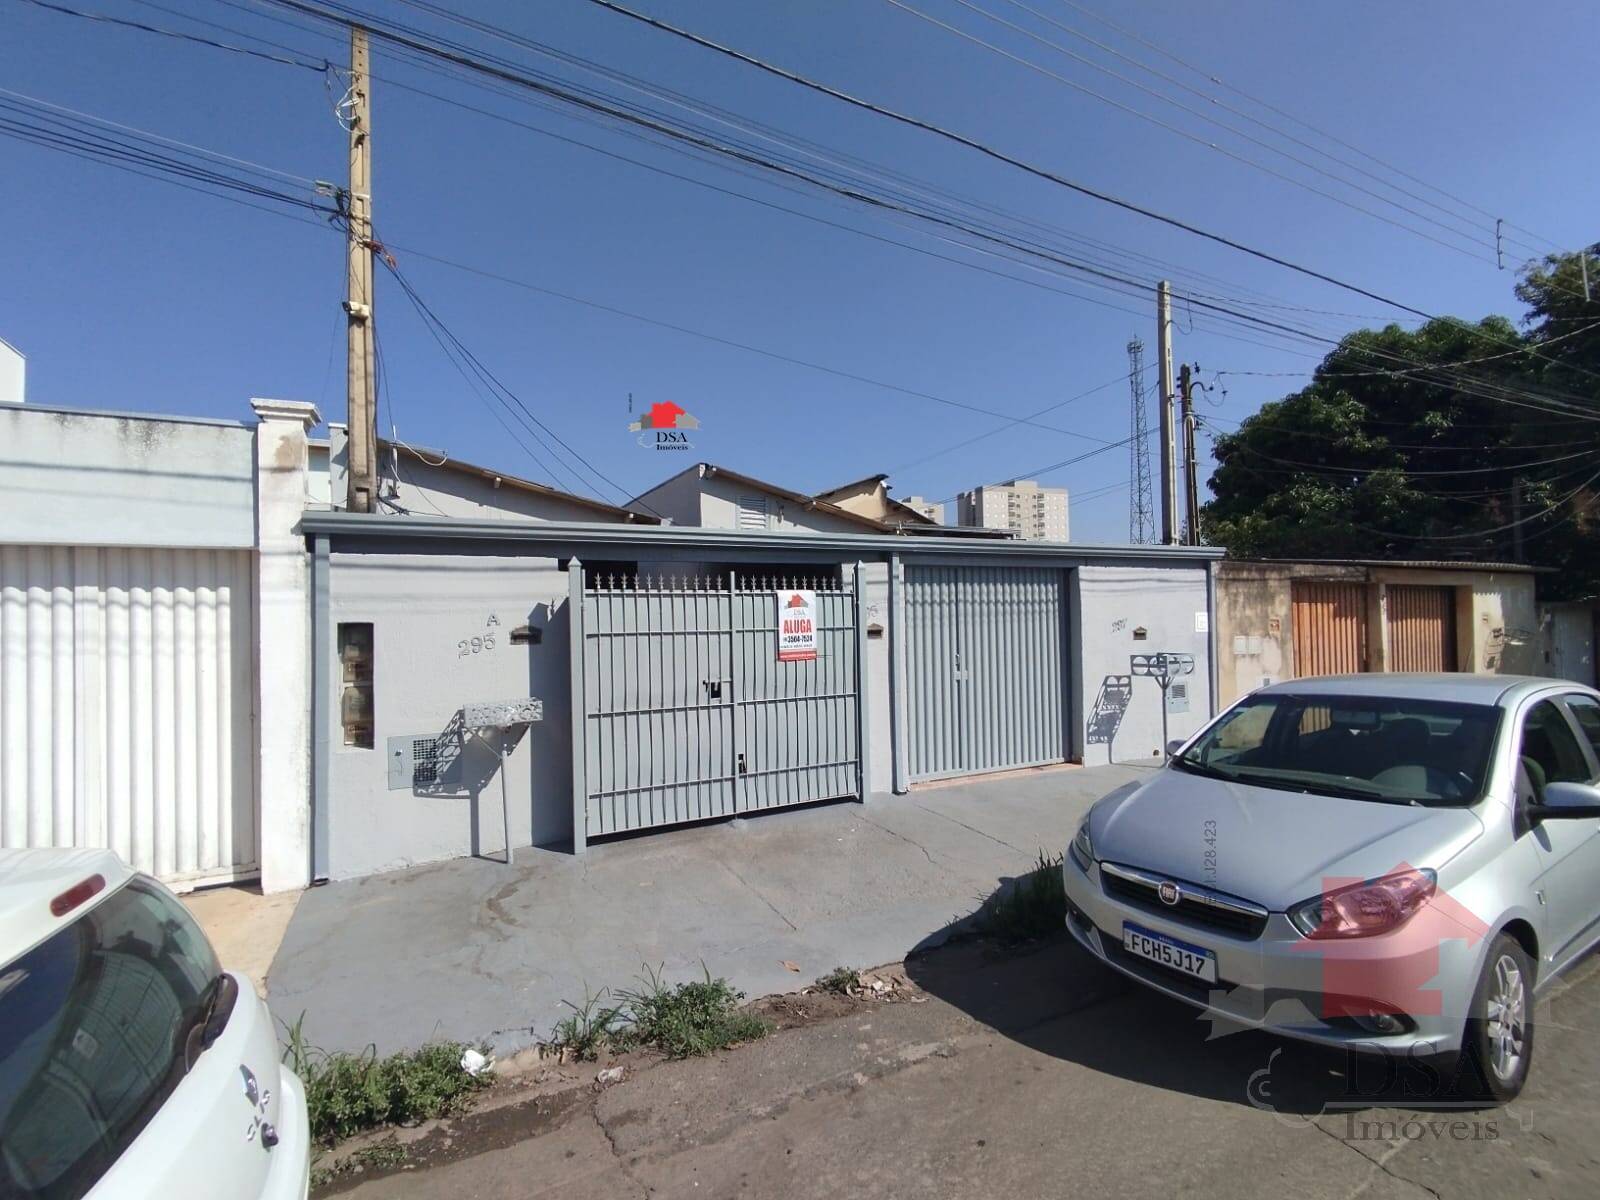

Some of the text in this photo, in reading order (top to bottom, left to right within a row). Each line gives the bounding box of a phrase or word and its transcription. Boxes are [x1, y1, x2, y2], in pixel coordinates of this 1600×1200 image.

[783, 618, 812, 634] ALUGA
[457, 632, 496, 660] 295
[1131, 934, 1205, 975] FCH5J17
